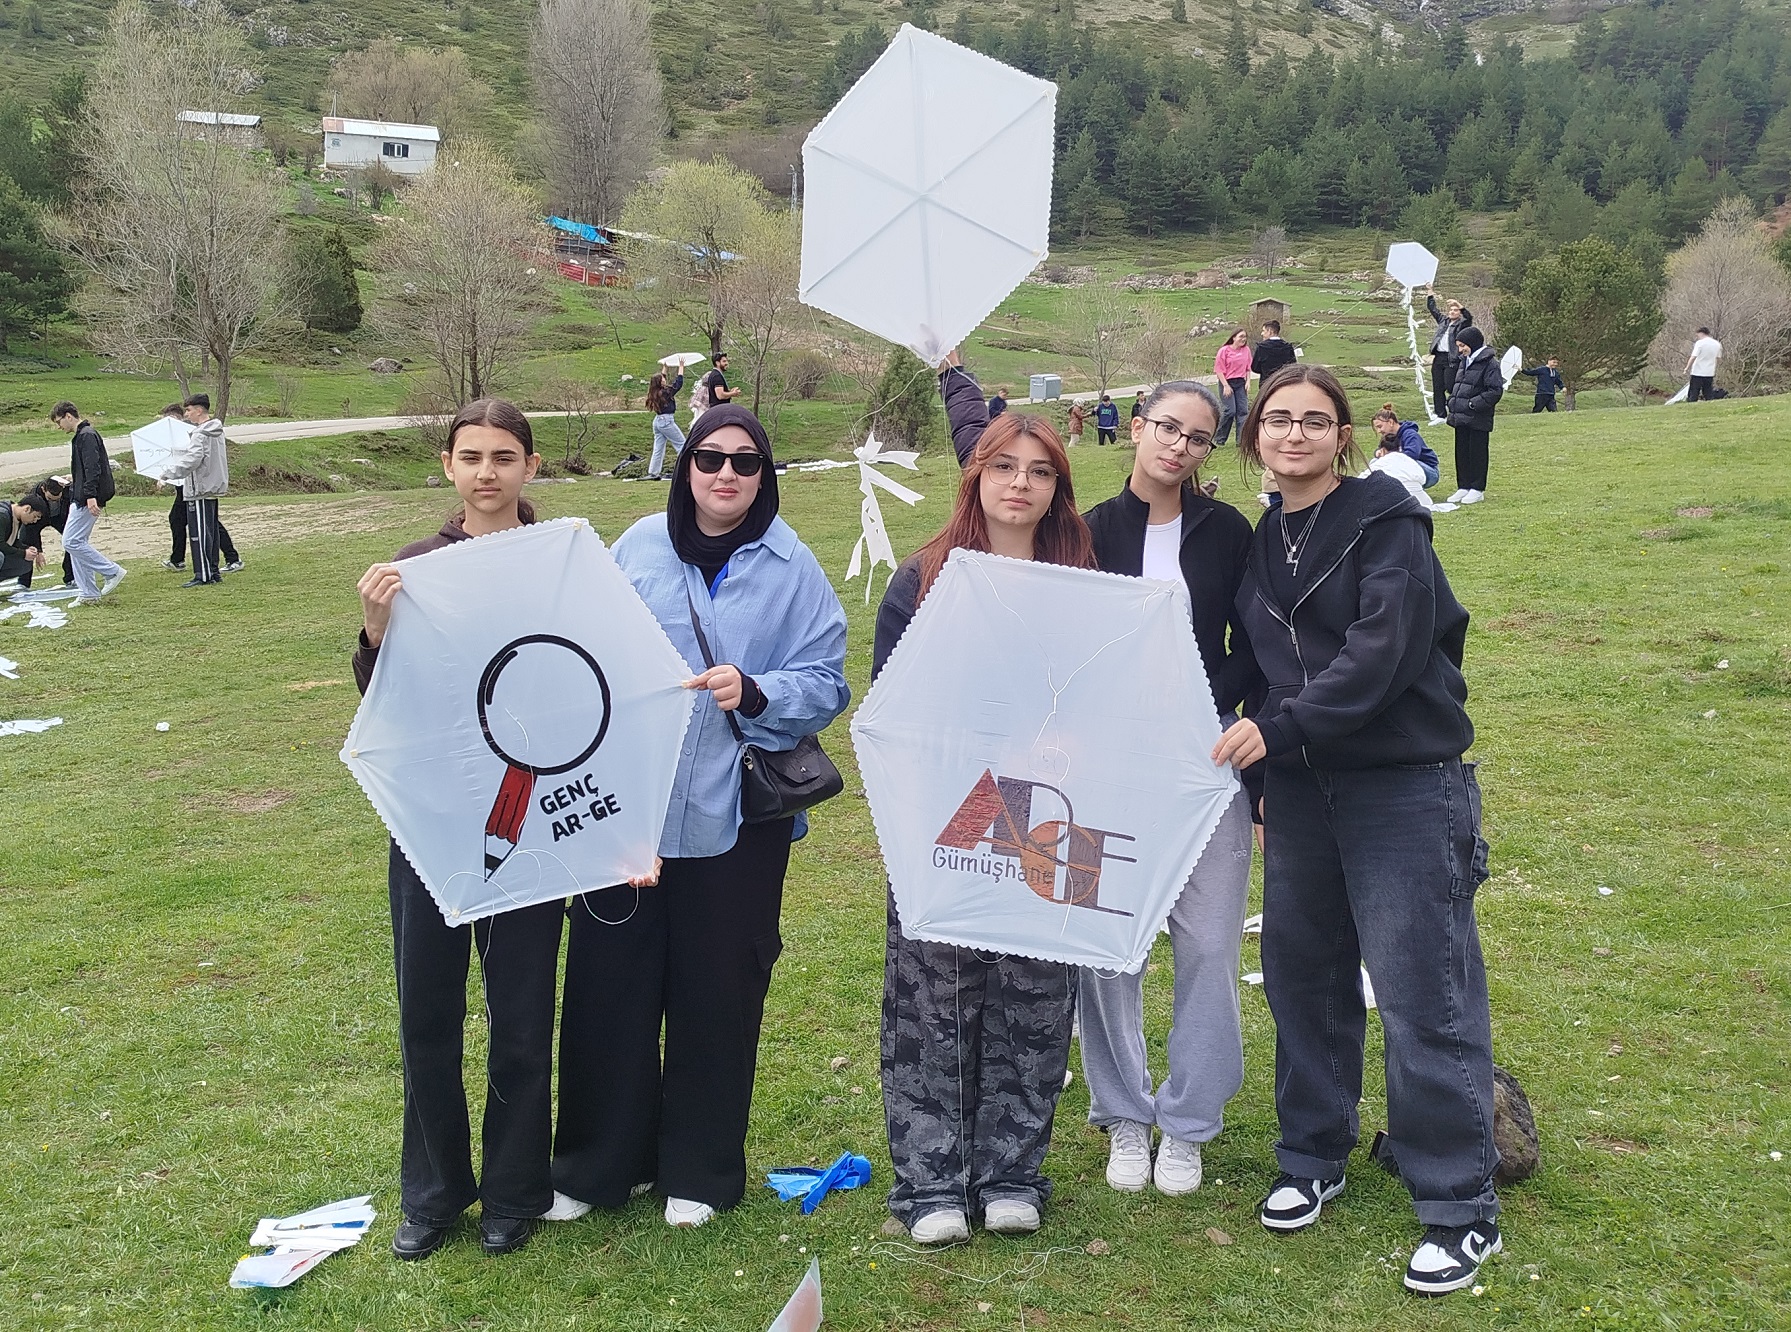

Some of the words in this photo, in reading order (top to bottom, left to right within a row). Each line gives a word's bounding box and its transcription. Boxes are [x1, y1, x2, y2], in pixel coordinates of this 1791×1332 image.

[540, 774, 599, 815] GENÇ
[552, 794, 622, 842] AR-GE
[932, 846, 1055, 885] Gümüşhane
